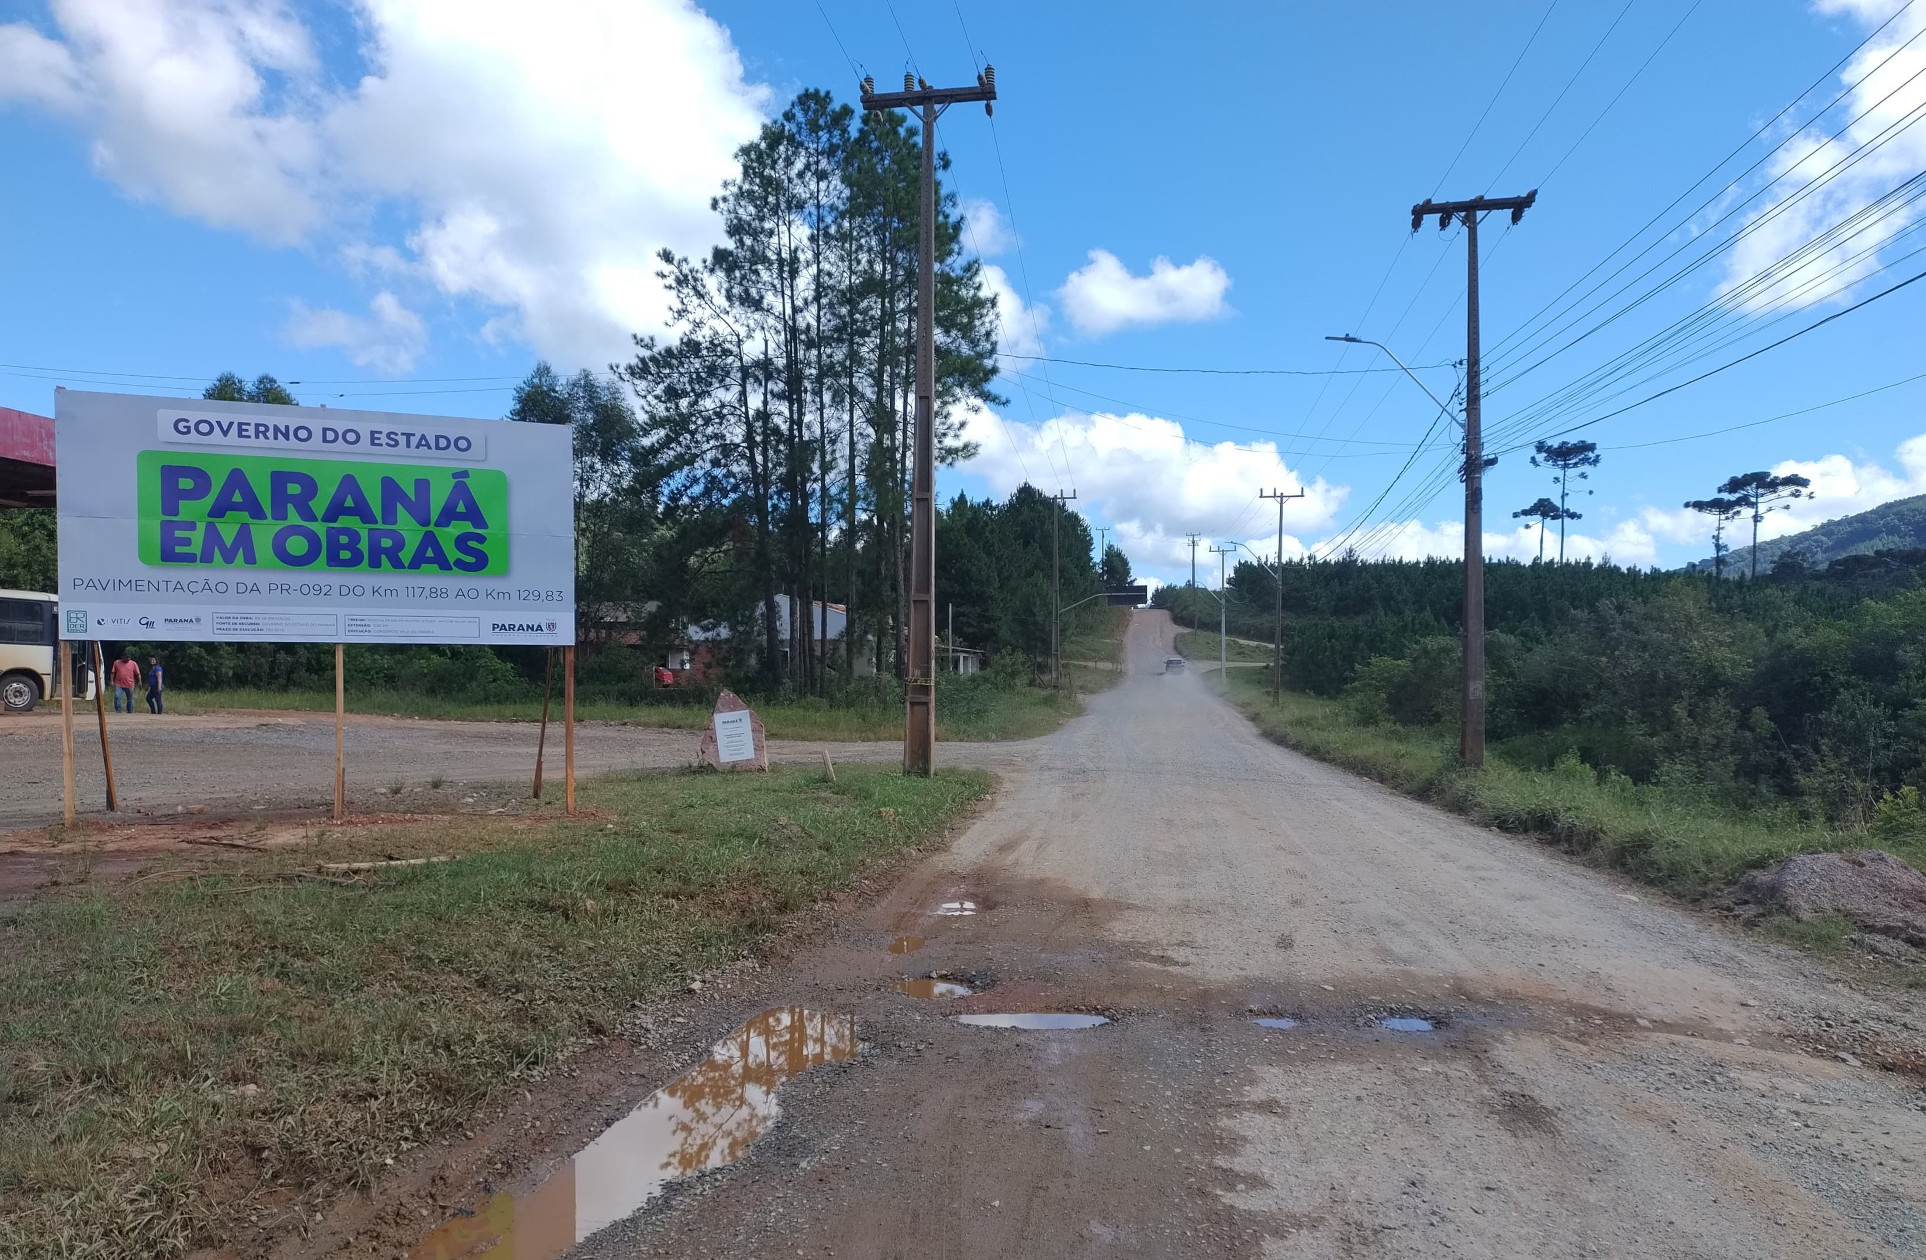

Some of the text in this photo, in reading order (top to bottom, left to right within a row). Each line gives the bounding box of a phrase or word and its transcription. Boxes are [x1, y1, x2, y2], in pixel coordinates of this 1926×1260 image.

[173, 417, 472, 453] GOVERNO DO ESTADO
[160, 465, 489, 530] PARANÁ
[160, 520, 490, 572] EM OBRAS
[73, 577, 564, 603] PAVIMENTAÇÃO DA PR-092 DO Km 117,88 AO Km 129,83
[111, 617, 131, 625] VITIS
[491, 621, 544, 632] PARANÁ
